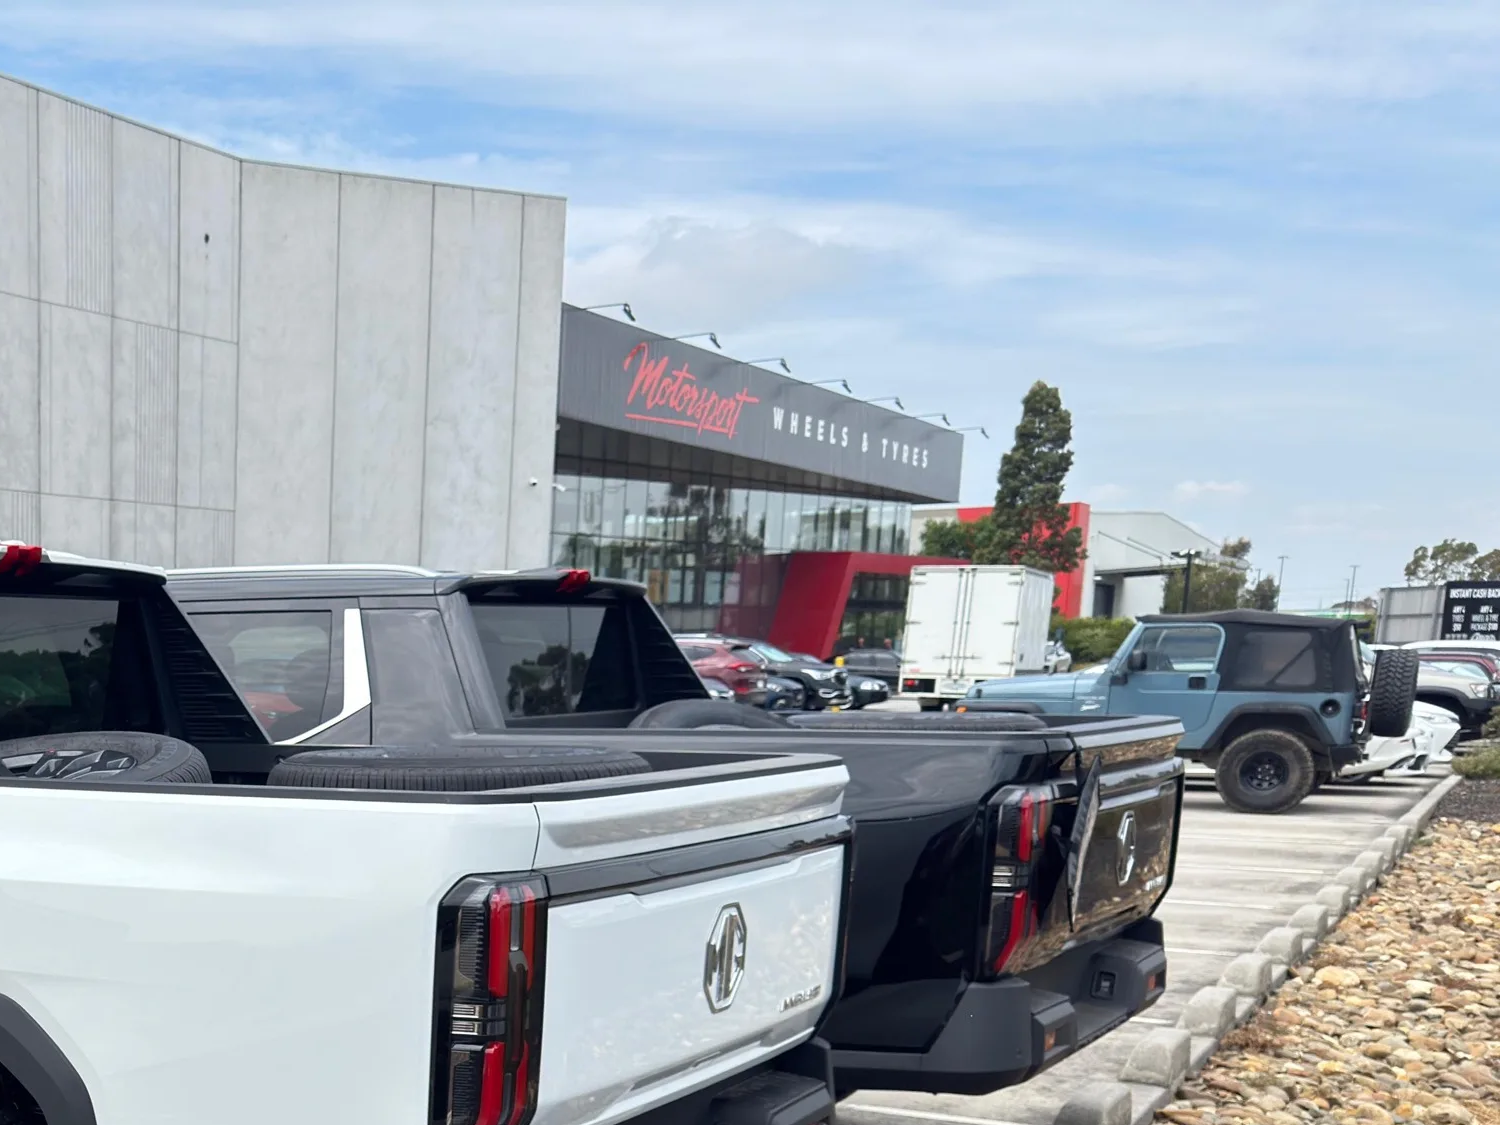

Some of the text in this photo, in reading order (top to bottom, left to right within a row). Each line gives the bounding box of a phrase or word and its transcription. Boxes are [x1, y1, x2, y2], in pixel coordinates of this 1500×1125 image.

[623, 342, 760, 439] Motorsport
[773, 406, 928, 469] WHEELS & TYRES
[1450, 588, 1472, 599] INSTANT
[1472, 588, 1487, 599] CASH
